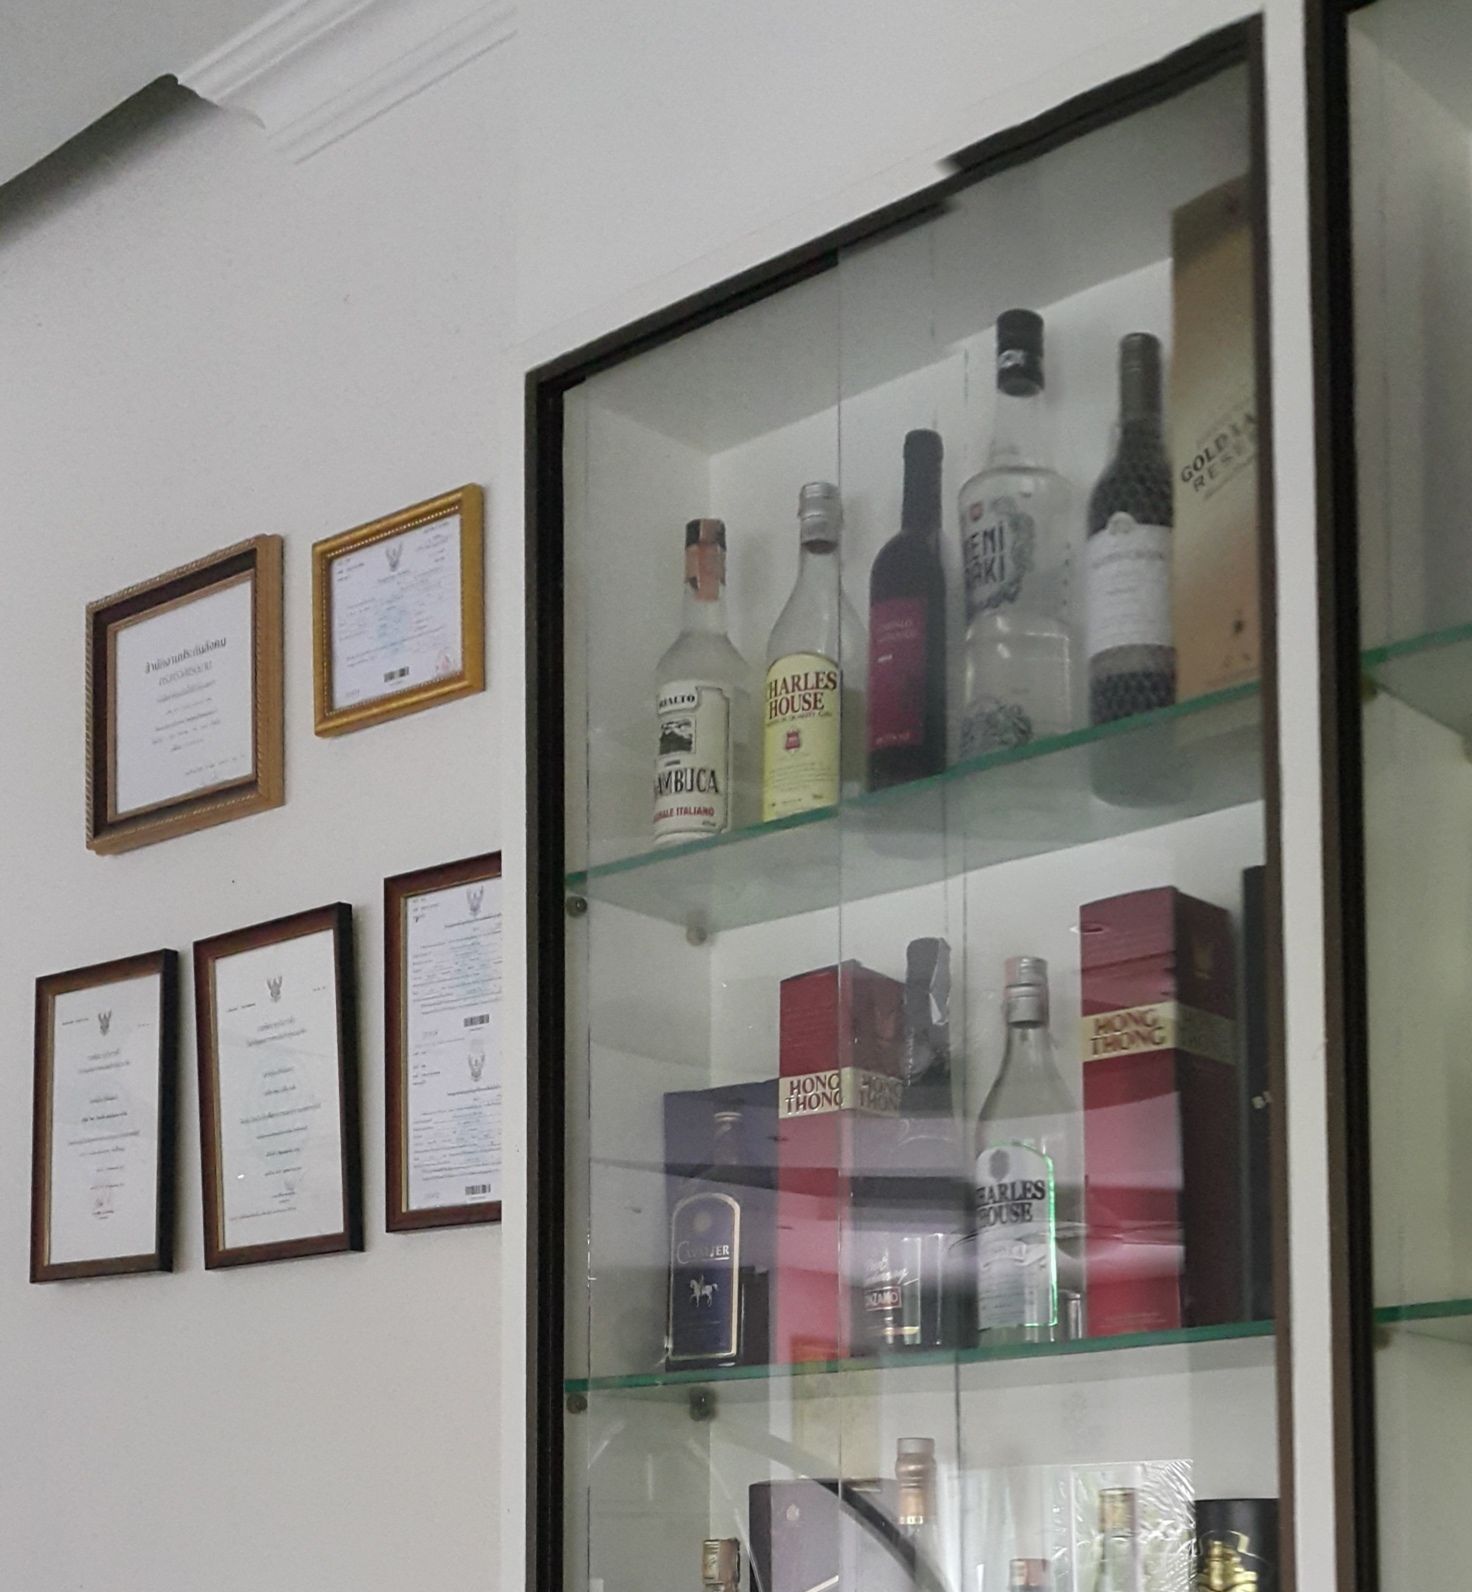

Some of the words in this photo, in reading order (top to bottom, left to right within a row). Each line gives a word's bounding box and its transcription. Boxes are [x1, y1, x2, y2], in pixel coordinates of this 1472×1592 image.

[1180, 432, 1229, 484] GOLD
[767, 671, 837, 700] HARLES
[769, 692, 825, 720] HOUSE
[676, 806, 715, 818] ITALIANO
[1093, 1008, 1158, 1037] HONG
[1090, 1026, 1165, 1056] THONG
